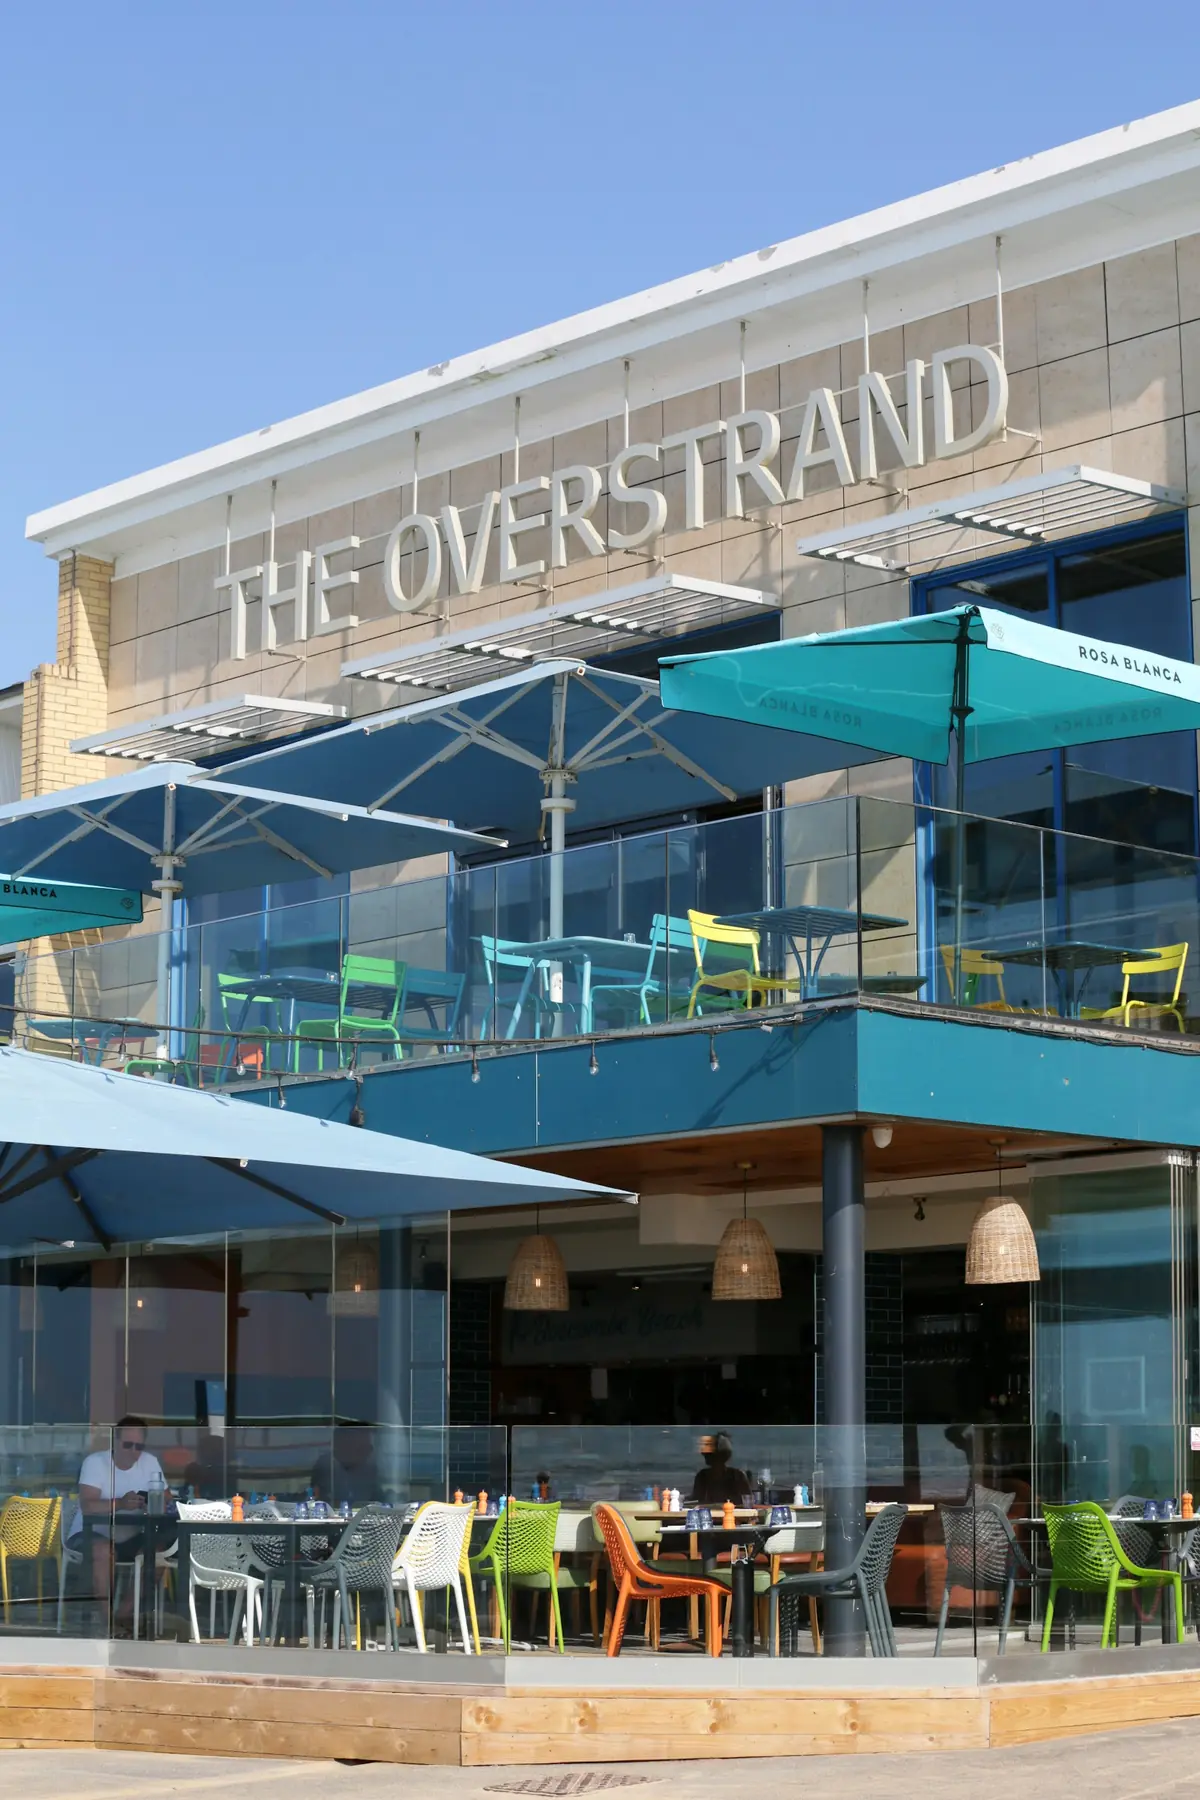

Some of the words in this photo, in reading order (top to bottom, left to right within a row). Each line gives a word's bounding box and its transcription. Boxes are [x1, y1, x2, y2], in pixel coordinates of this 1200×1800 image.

[214, 535, 360, 661] THE
[384, 344, 1008, 612] OVERSTRAND
[1078, 645, 1119, 667] ROSA
[1123, 657, 1182, 684] BLANCA
[3, 883, 58, 898] BLANCA
